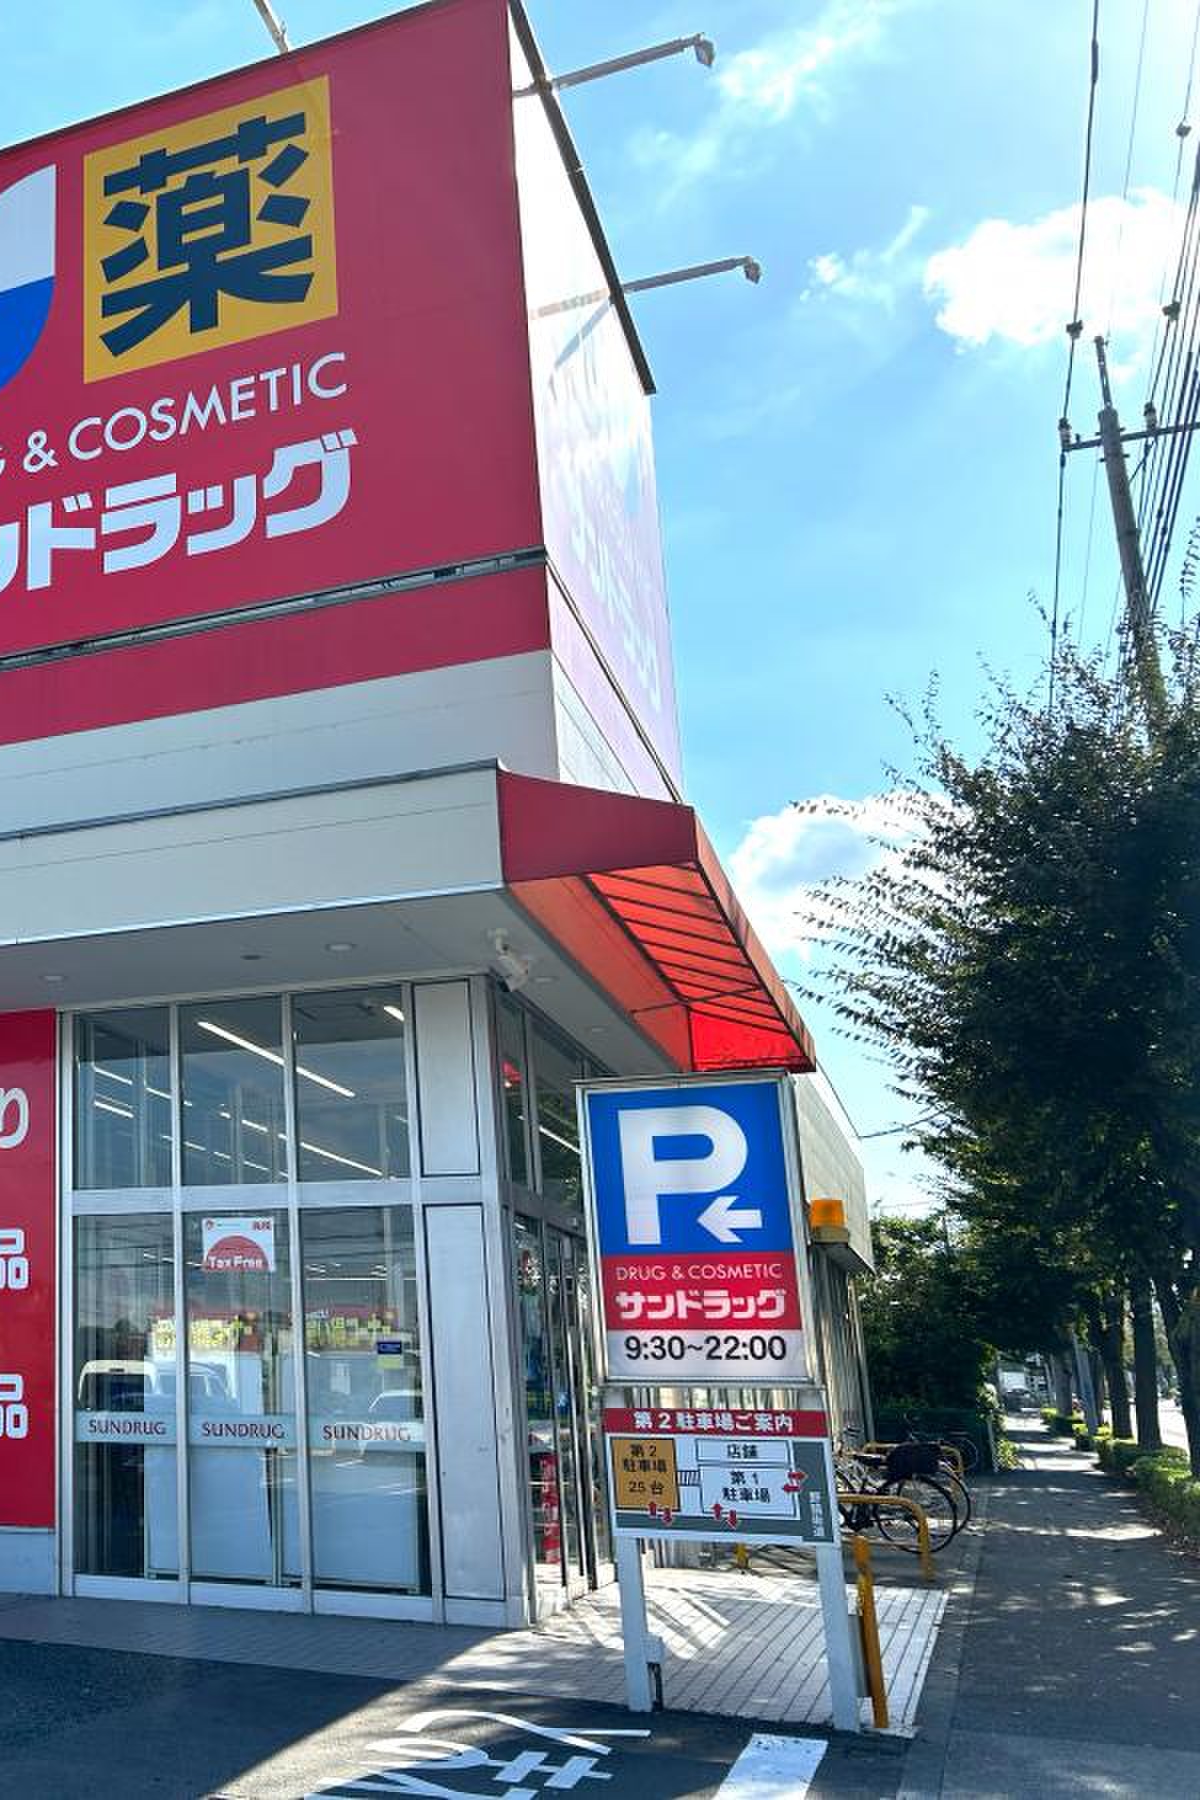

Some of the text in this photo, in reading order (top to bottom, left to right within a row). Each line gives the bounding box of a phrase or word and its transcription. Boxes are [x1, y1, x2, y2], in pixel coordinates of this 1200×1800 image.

[98, 112, 314, 359] 薬
[23, 432, 58, 473] &
[69, 351, 348, 461] COSMETIC
[618, 1105, 748, 1245] P
[616, 1263, 783, 1281] DRUG & COSMETIC
[615, 1288, 786, 1319] サンドラッグ
[88, 1419, 167, 1435] SUNDRUG
[202, 1422, 285, 1439] SUNDRUG
[322, 1424, 411, 1441] SUNDRUG
